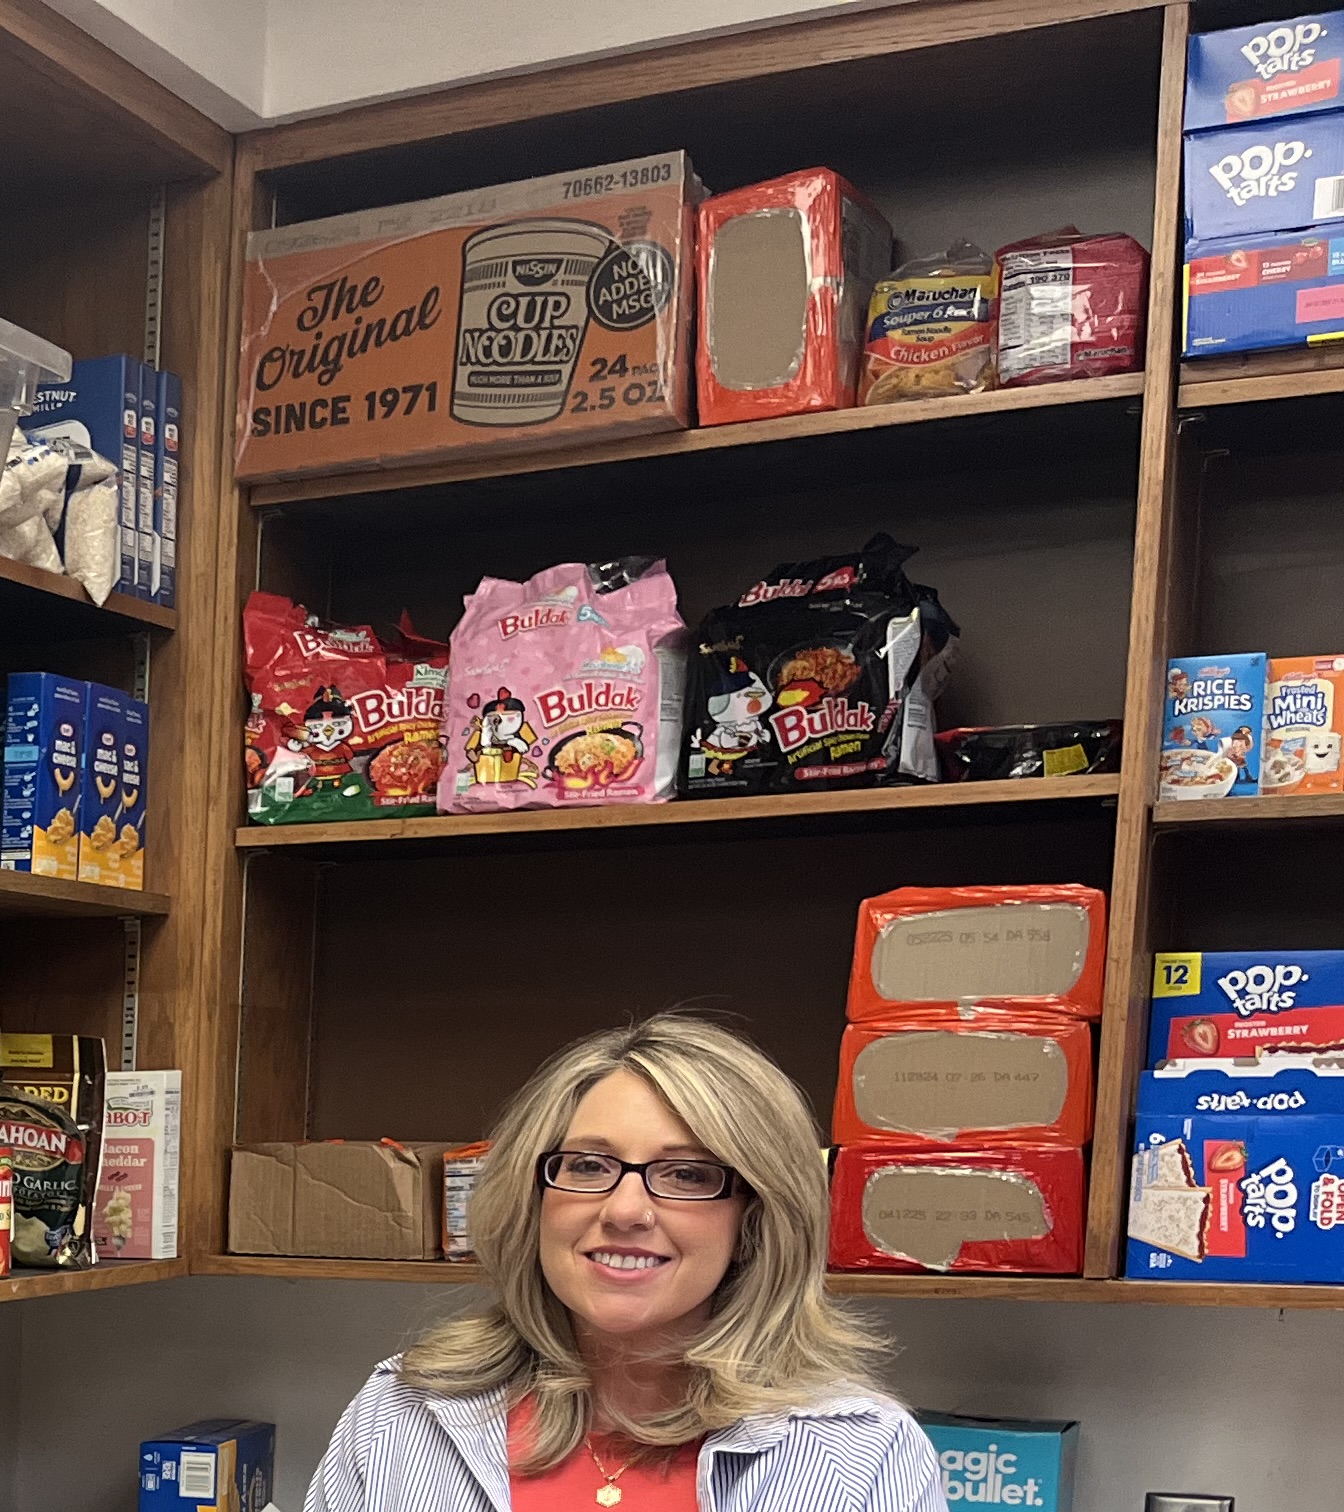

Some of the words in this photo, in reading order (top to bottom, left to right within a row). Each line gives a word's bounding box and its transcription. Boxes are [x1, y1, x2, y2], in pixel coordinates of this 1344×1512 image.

[1255, 46, 1315, 79] tarts
[562, 163, 672, 200] 70662-13803
[1227, 170, 1298, 206] tarts
[515, 260, 558, 278] NISSIN
[297, 275, 383, 333] The
[488, 292, 570, 330] CUP
[613, 294, 653, 319] MSG
[903, 286, 977, 303] Maruchan
[256, 286, 443, 391] Original
[460, 327, 579, 366] NOODLES
[890, 344, 949, 363] Chicken
[952, 333, 985, 351] Flavor
[589, 354, 629, 382] 24
[252, 395, 351, 438] SINCE
[365, 381, 438, 421] 1971
[498, 607, 570, 641] Buldak
[1193, 679, 1236, 696] RICE
[536, 682, 640, 728] Buldak
[1174, 694, 1252, 716] KRISPIES
[1269, 709, 1326, 729] Wheats
[768, 697, 876, 752] Buldak
[1163, 964, 1189, 984] 12
[1233, 990, 1296, 1016] tarts
[1227, 1025, 1309, 1039] STRAWBERRY
[23, 1176, 78, 1191] GARLIC
[1241, 1173, 1265, 1229] tarts
[1320, 1188, 1333, 1227] FOLD
[939, 1444, 1017, 1480] agic
